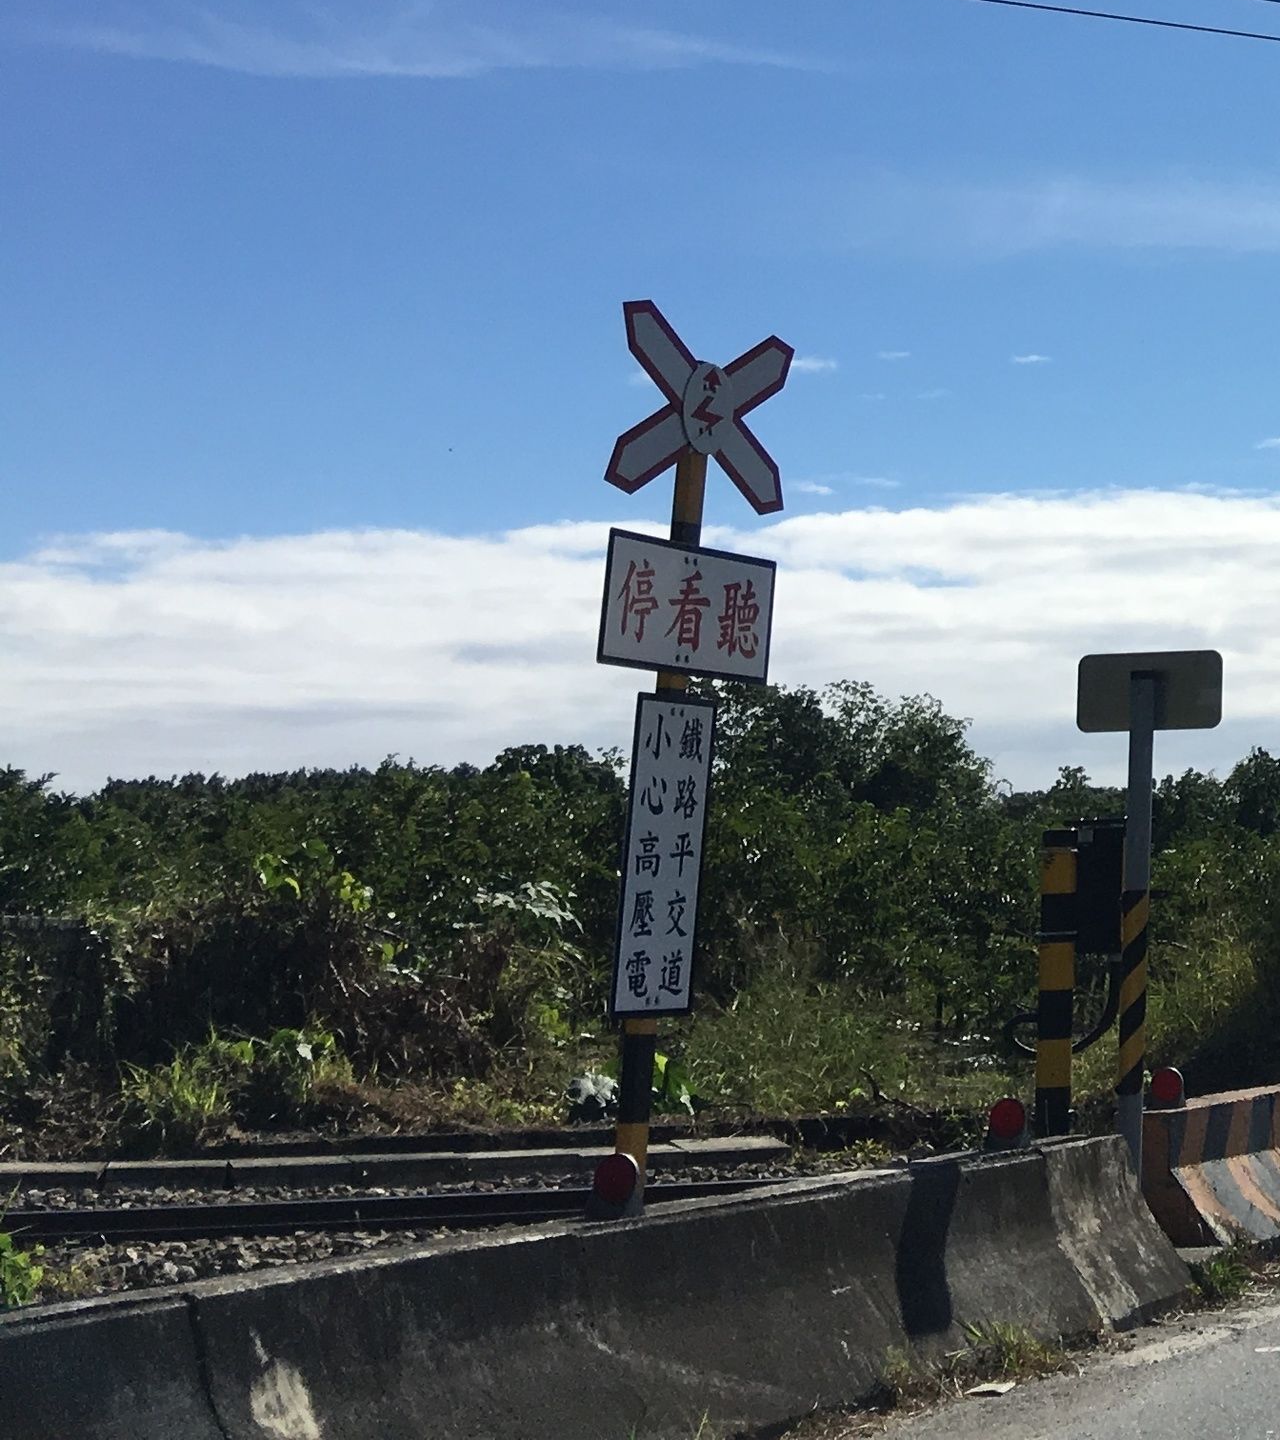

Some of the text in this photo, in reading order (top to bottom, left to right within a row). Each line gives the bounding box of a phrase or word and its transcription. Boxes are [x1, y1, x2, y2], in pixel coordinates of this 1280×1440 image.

[616, 559, 762, 660] 停看聽
[625, 713, 671, 999] 小心高壓電
[657, 717, 704, 996] 鐵路平交道
